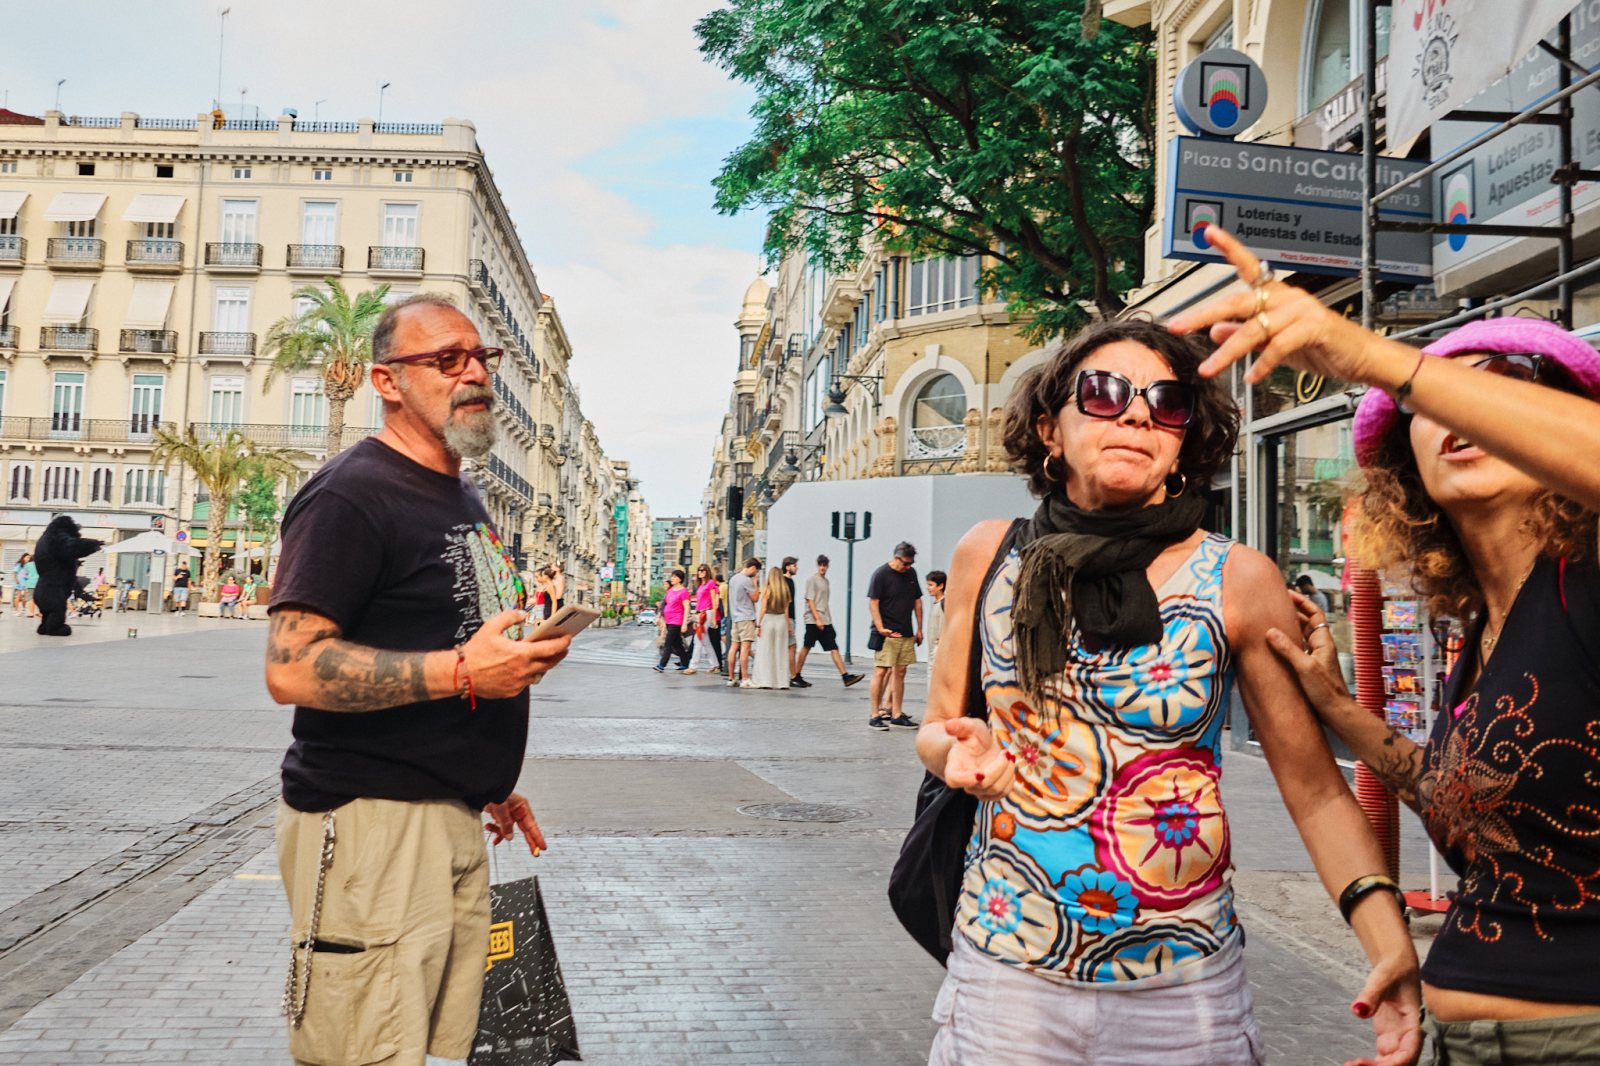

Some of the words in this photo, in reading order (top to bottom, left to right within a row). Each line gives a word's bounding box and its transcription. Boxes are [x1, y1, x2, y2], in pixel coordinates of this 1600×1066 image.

[1324, 88, 1356, 132] SALA
[1183, 151, 1232, 168] Plaza
[1488, 159, 1553, 206] Apuestas
[1237, 206, 1291, 223] Loterías
[1294, 214, 1303, 226] y
[1236, 222, 1297, 244] Apuestas
[1301, 228, 1320, 242] del
[1324, 231, 1363, 247] Estad
